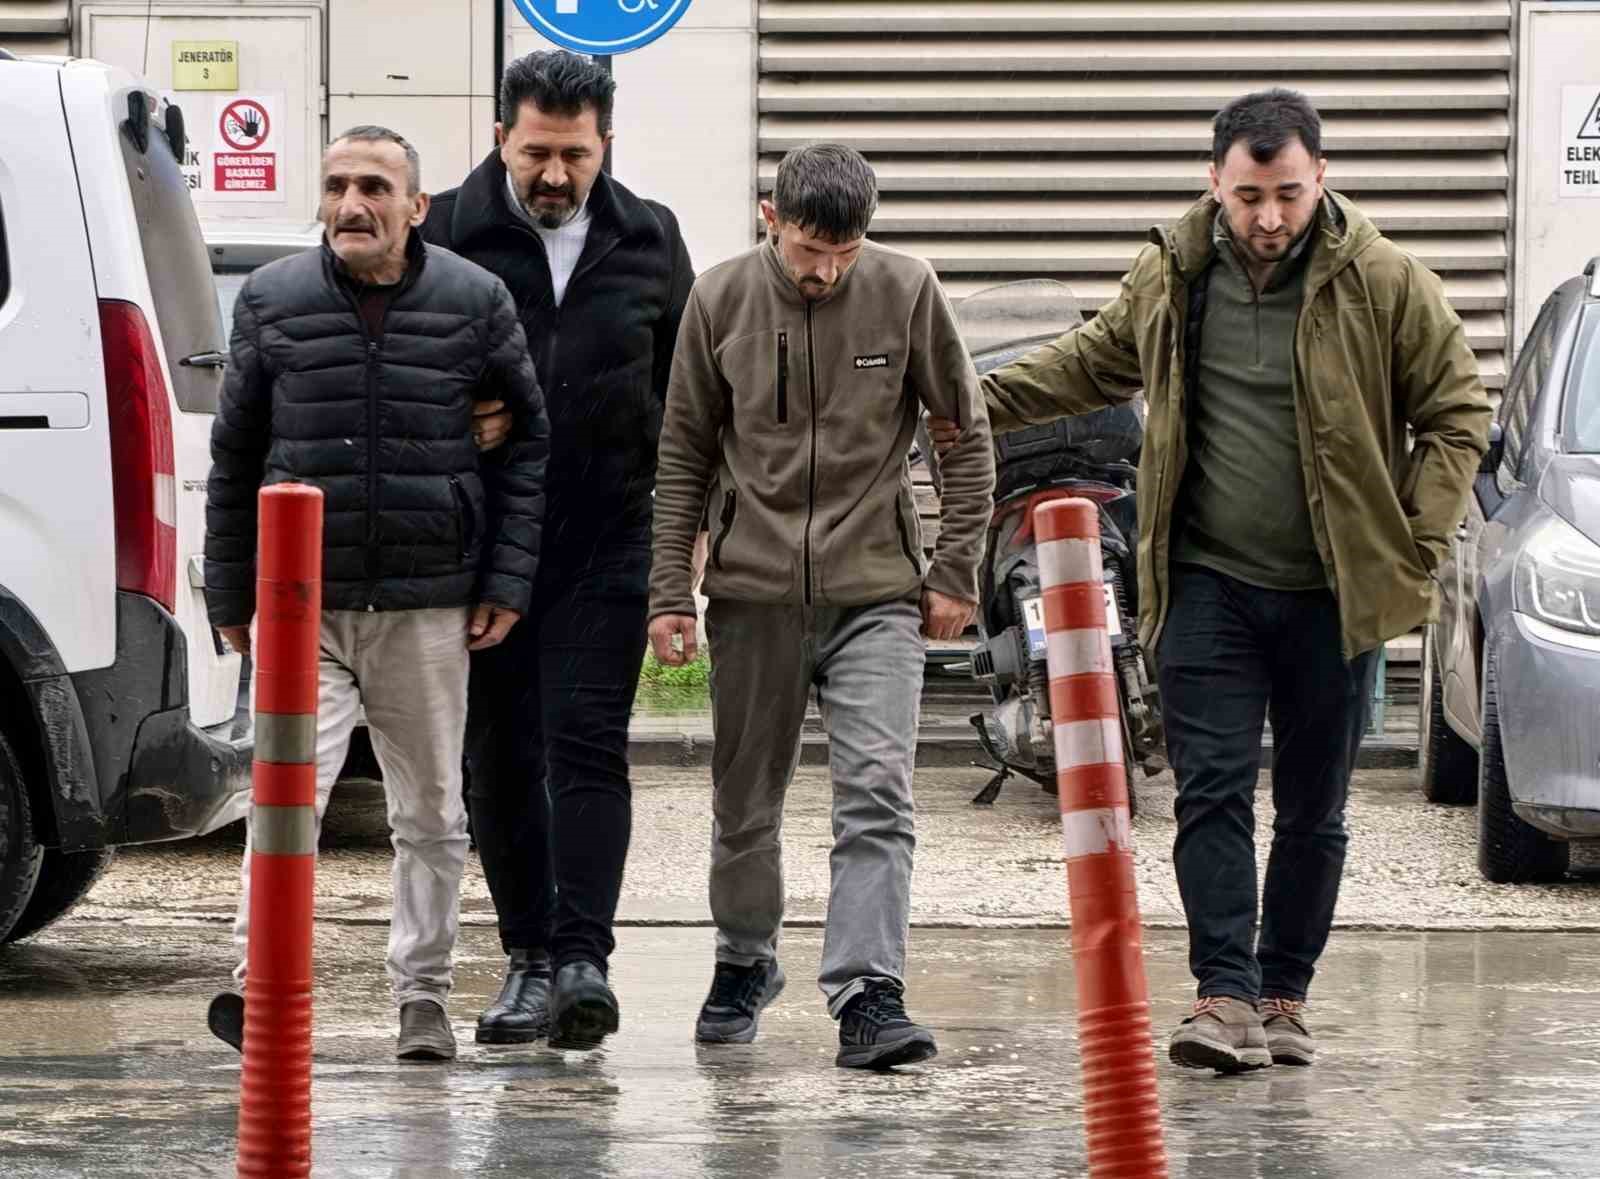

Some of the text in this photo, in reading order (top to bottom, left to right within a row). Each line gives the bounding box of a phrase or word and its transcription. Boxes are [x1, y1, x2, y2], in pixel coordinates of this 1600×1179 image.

[178, 49, 233, 63] JENERATÖR
[203, 68, 209, 79] 3
[1567, 146, 1600, 161] ELEK
[862, 357, 887, 367] Columbia
